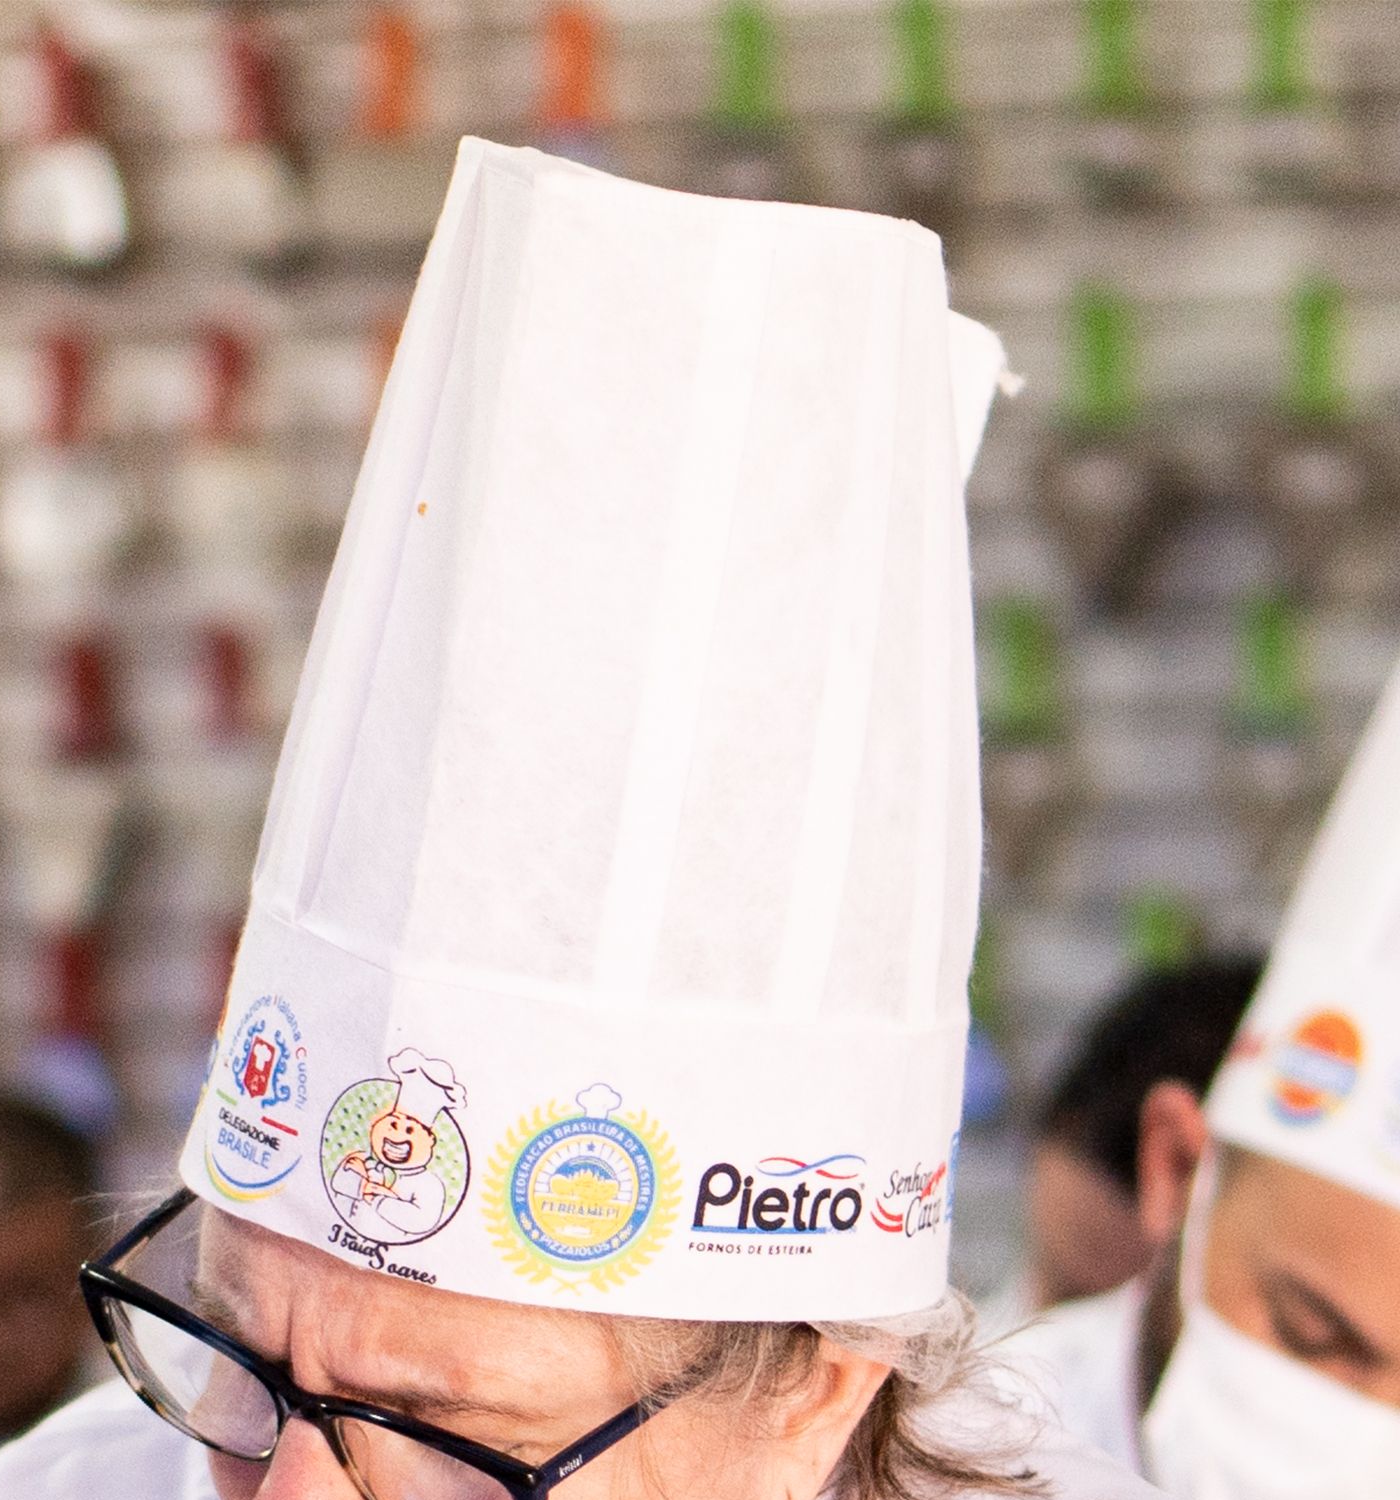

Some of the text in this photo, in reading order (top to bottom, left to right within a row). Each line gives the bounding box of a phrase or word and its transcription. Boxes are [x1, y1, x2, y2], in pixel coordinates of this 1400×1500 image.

[217, 1127, 272, 1169] BRASILE
[218, 1106, 281, 1151] DELEGAZIONE
[693, 1162, 863, 1232] Pietro
[689, 1242, 813, 1255] FORNOS DE ESTEIRA
